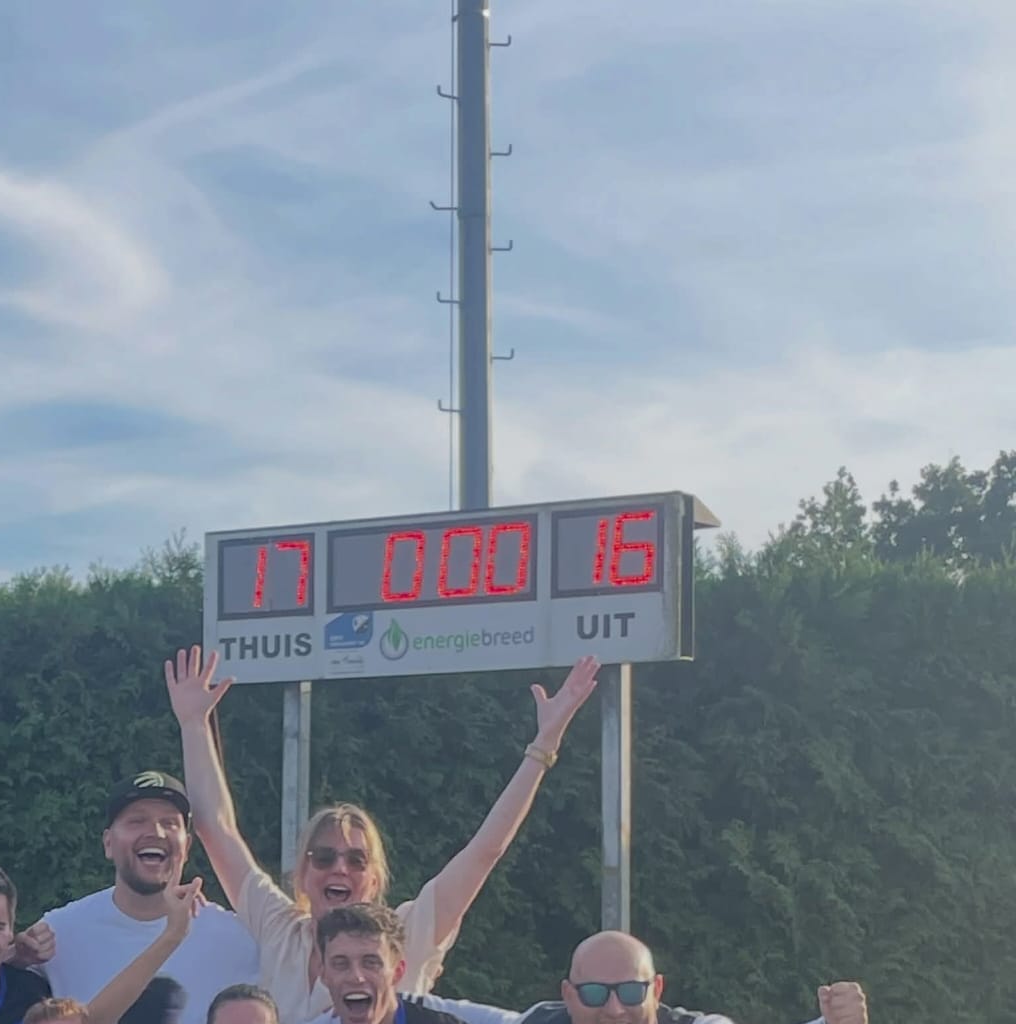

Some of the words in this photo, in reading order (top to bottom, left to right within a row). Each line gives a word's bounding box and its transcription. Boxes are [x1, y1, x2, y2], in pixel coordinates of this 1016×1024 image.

[592, 511, 655, 586] 16
[253, 541, 311, 608] 17
[413, 627, 534, 652] energiebreed
[577, 612, 635, 640] UIT
[219, 633, 312, 660] THUIS
